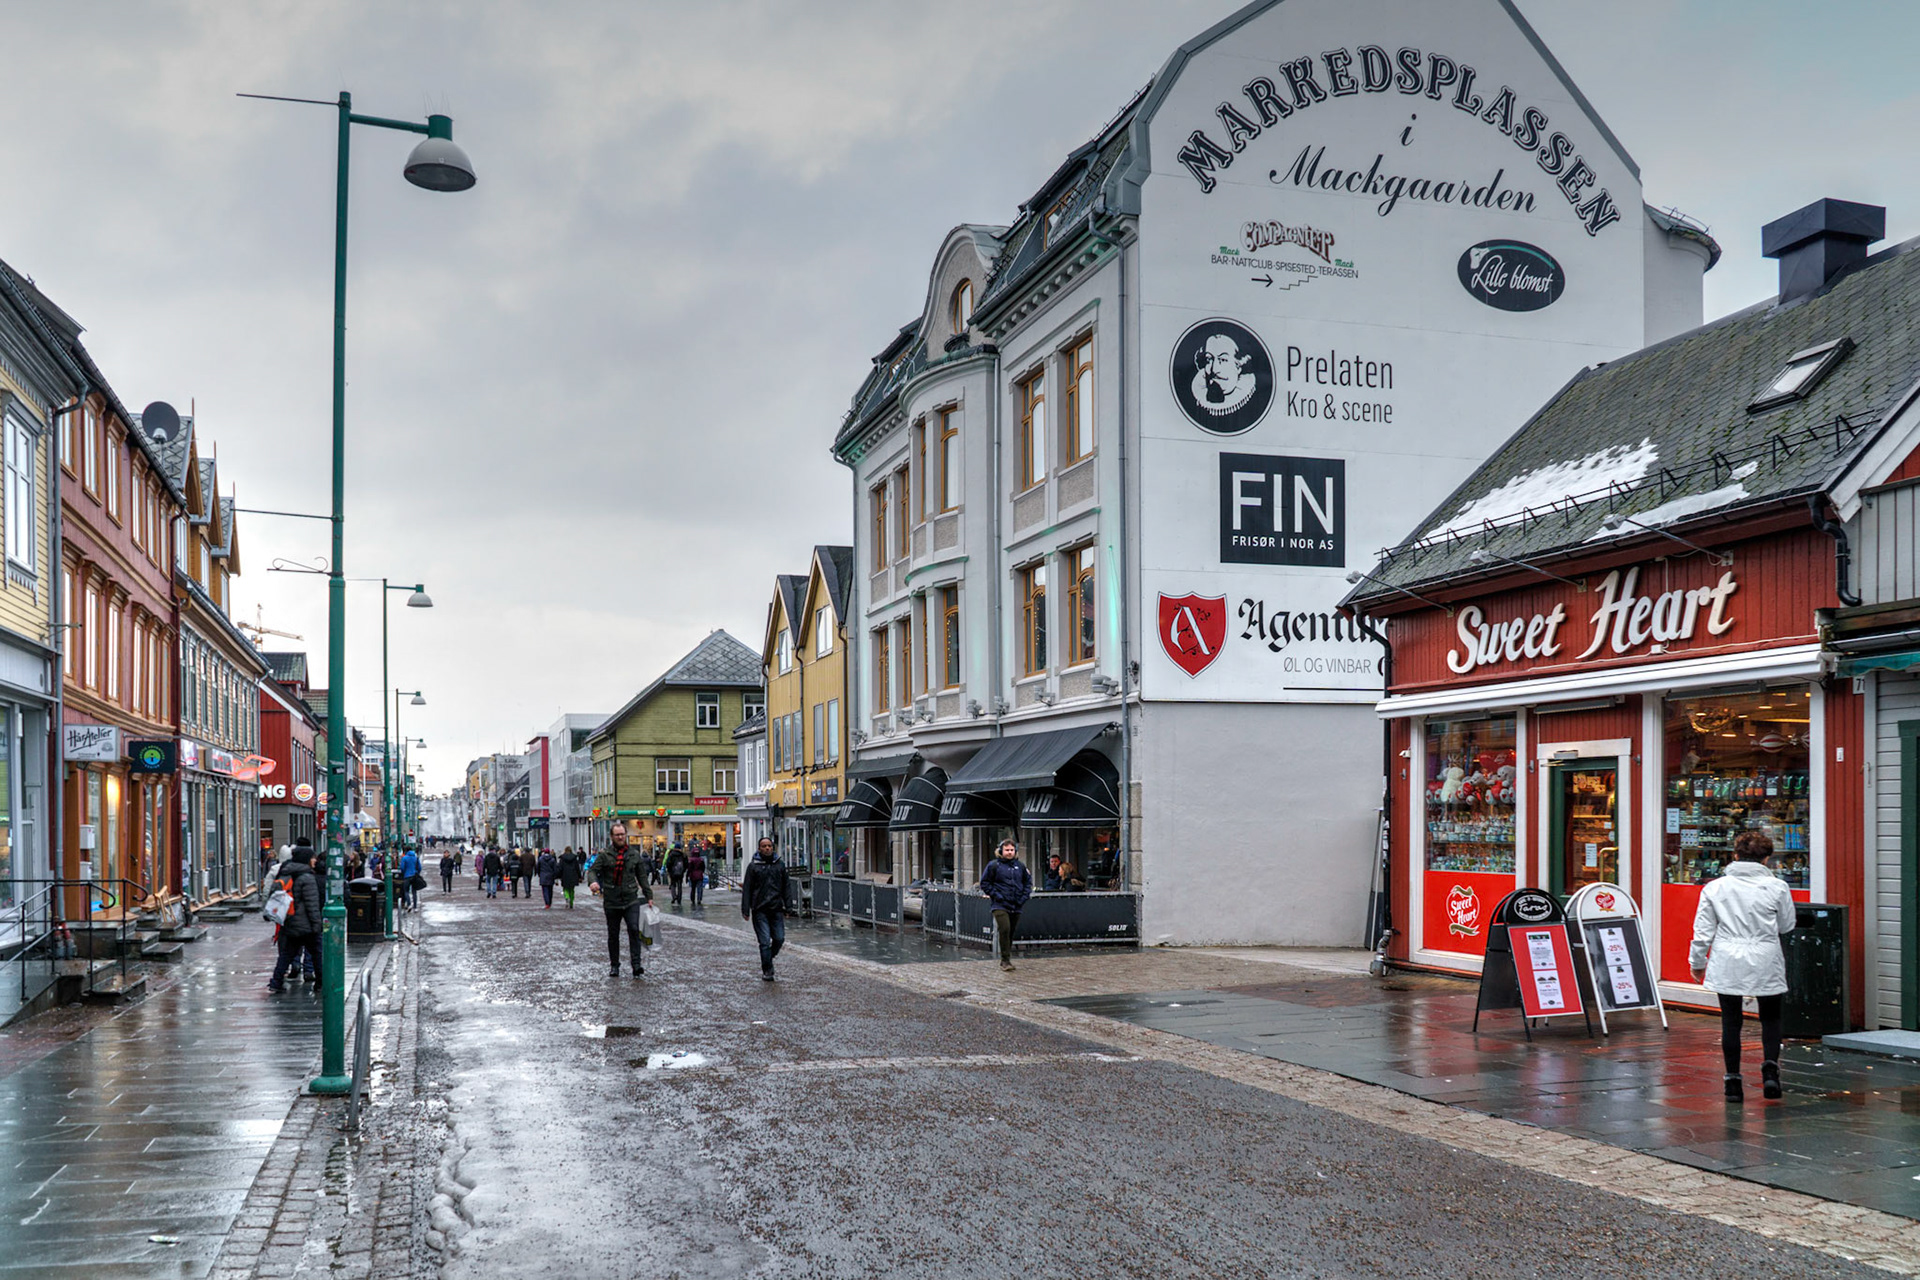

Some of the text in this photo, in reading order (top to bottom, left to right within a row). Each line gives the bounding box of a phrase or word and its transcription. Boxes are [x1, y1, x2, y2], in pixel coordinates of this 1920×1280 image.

[1177, 44, 1621, 237] MARKEDSPLASSEN
[1399, 113, 1418, 147] i
[1269, 144, 1538, 218] Mackgaarden
[1471, 254, 1554, 295] Lille blomst
[1287, 346, 1393, 389] Prelaten
[1287, 391, 1393, 424] Kro & scene
[1232, 471, 1334, 535] FIN
[1232, 535, 1334, 550] FRISØR I NOR AS
[1238, 598, 1388, 653] Agentur
[1447, 566, 1737, 674] Sweet Heart
[1283, 657, 1301, 673] ØL
[1304, 657, 1323, 673] OG
[1326, 658, 1371, 674] VINBAR
[1450, 896, 1472, 916] Sweet
[1457, 909, 1476, 925] Heart
